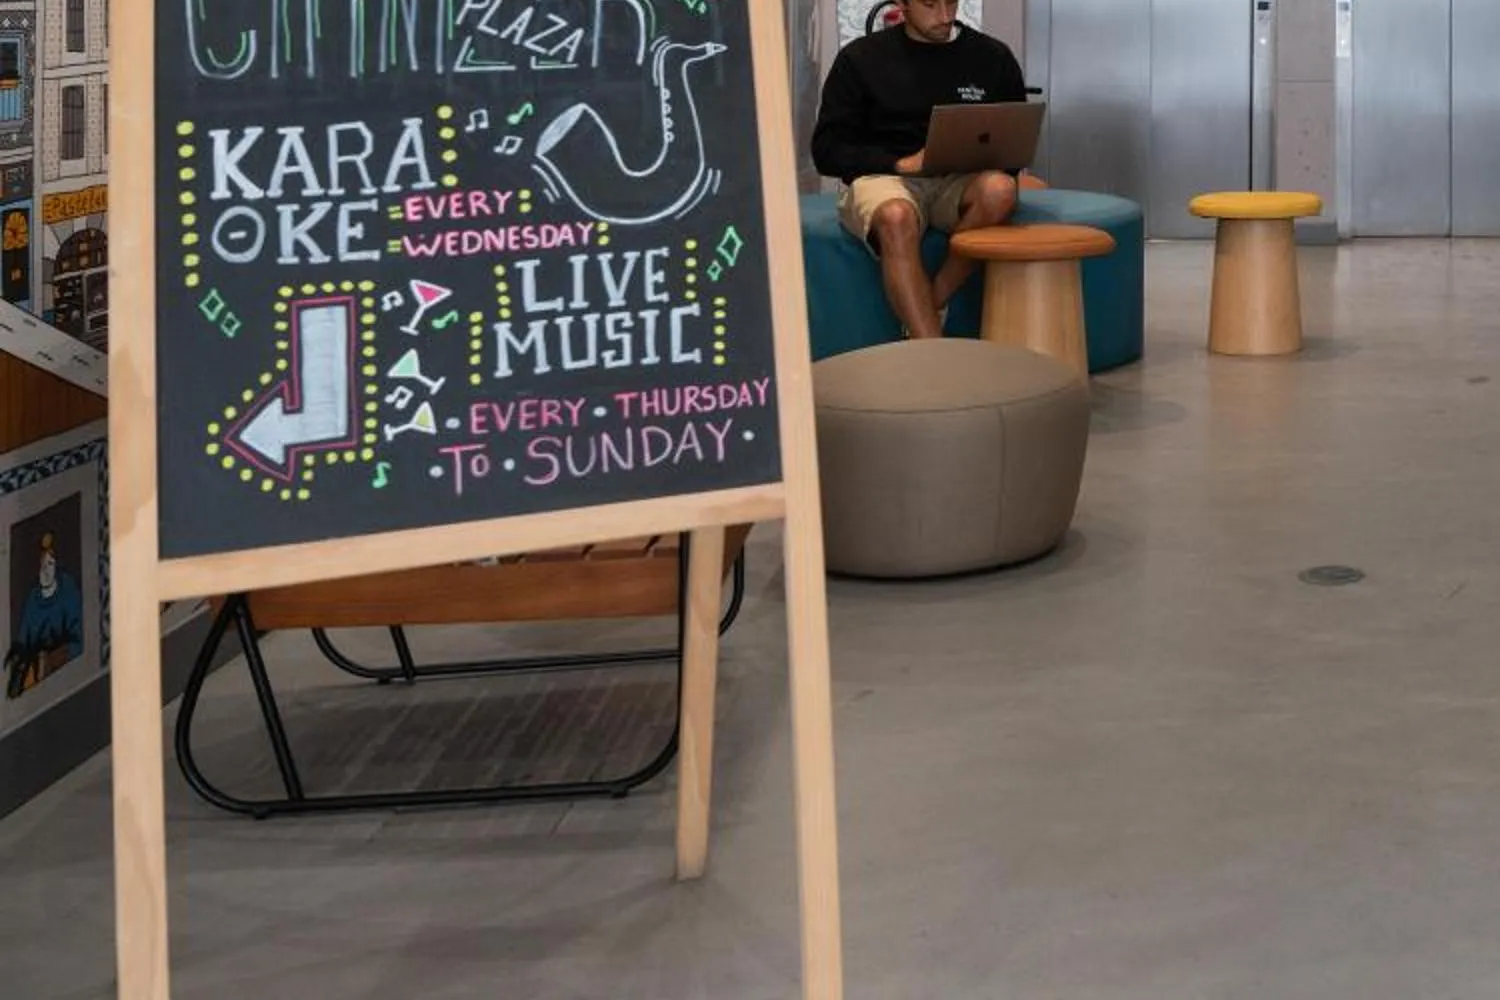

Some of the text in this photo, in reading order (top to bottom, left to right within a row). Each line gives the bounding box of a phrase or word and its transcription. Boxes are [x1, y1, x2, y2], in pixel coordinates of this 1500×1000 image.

[209, 118, 437, 199] KARA
[405, 190, 513, 221] EVERY
[401, 222, 593, 257] WEDNESDAY
[515, 247, 669, 312] LIVE
[493, 303, 701, 378] MUSIC
[470, 377, 770, 434] EVERY THURSDAY
[524, 418, 733, 486] SUNDAY
